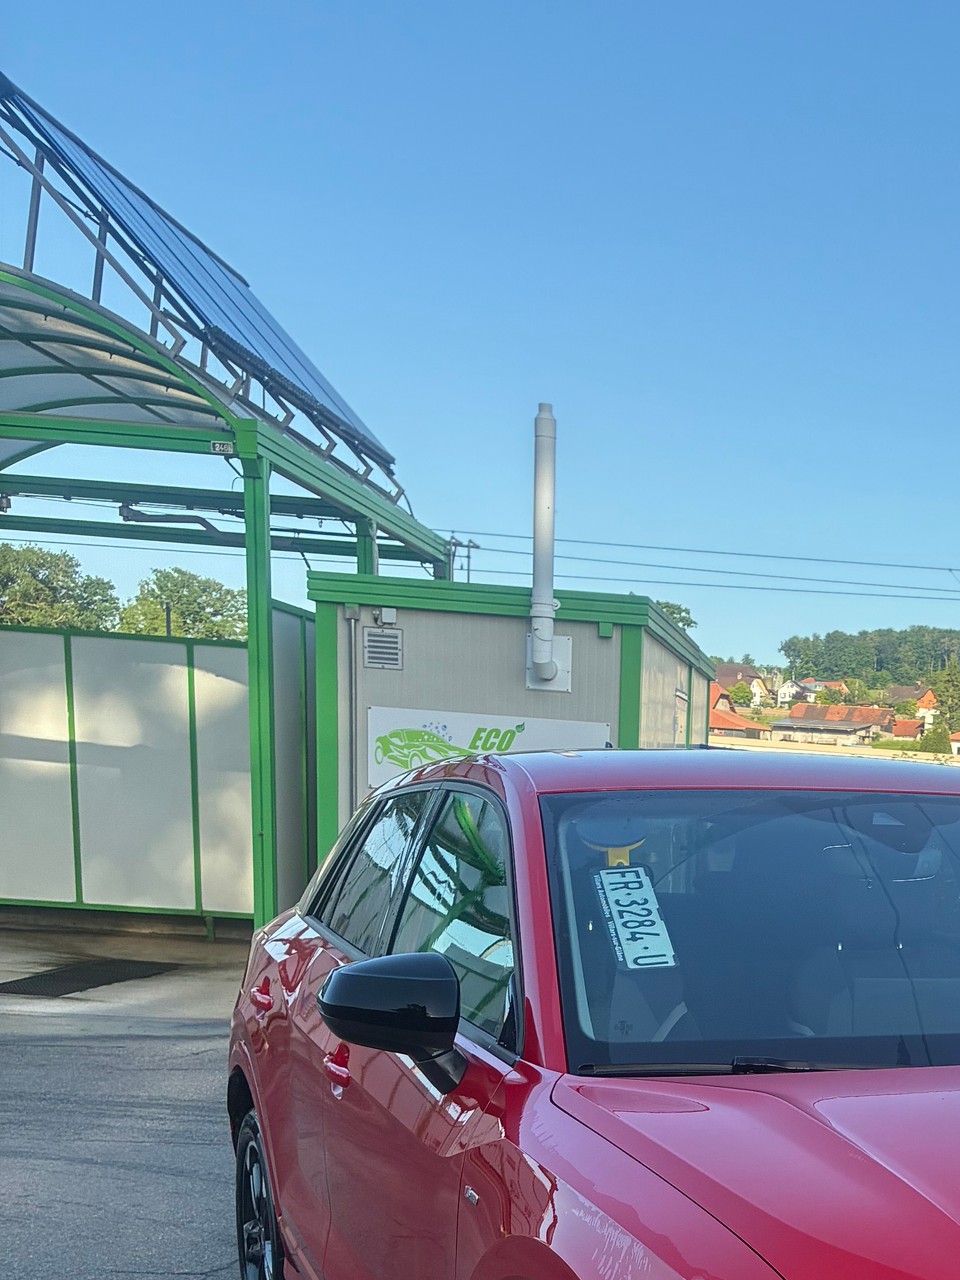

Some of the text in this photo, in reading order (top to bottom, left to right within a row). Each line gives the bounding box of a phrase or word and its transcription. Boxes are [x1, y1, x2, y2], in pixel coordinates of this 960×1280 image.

[468, 727, 517, 752] ECO
[593, 874, 602, 889] Villars
[598, 889, 611, 918] Automobiles
